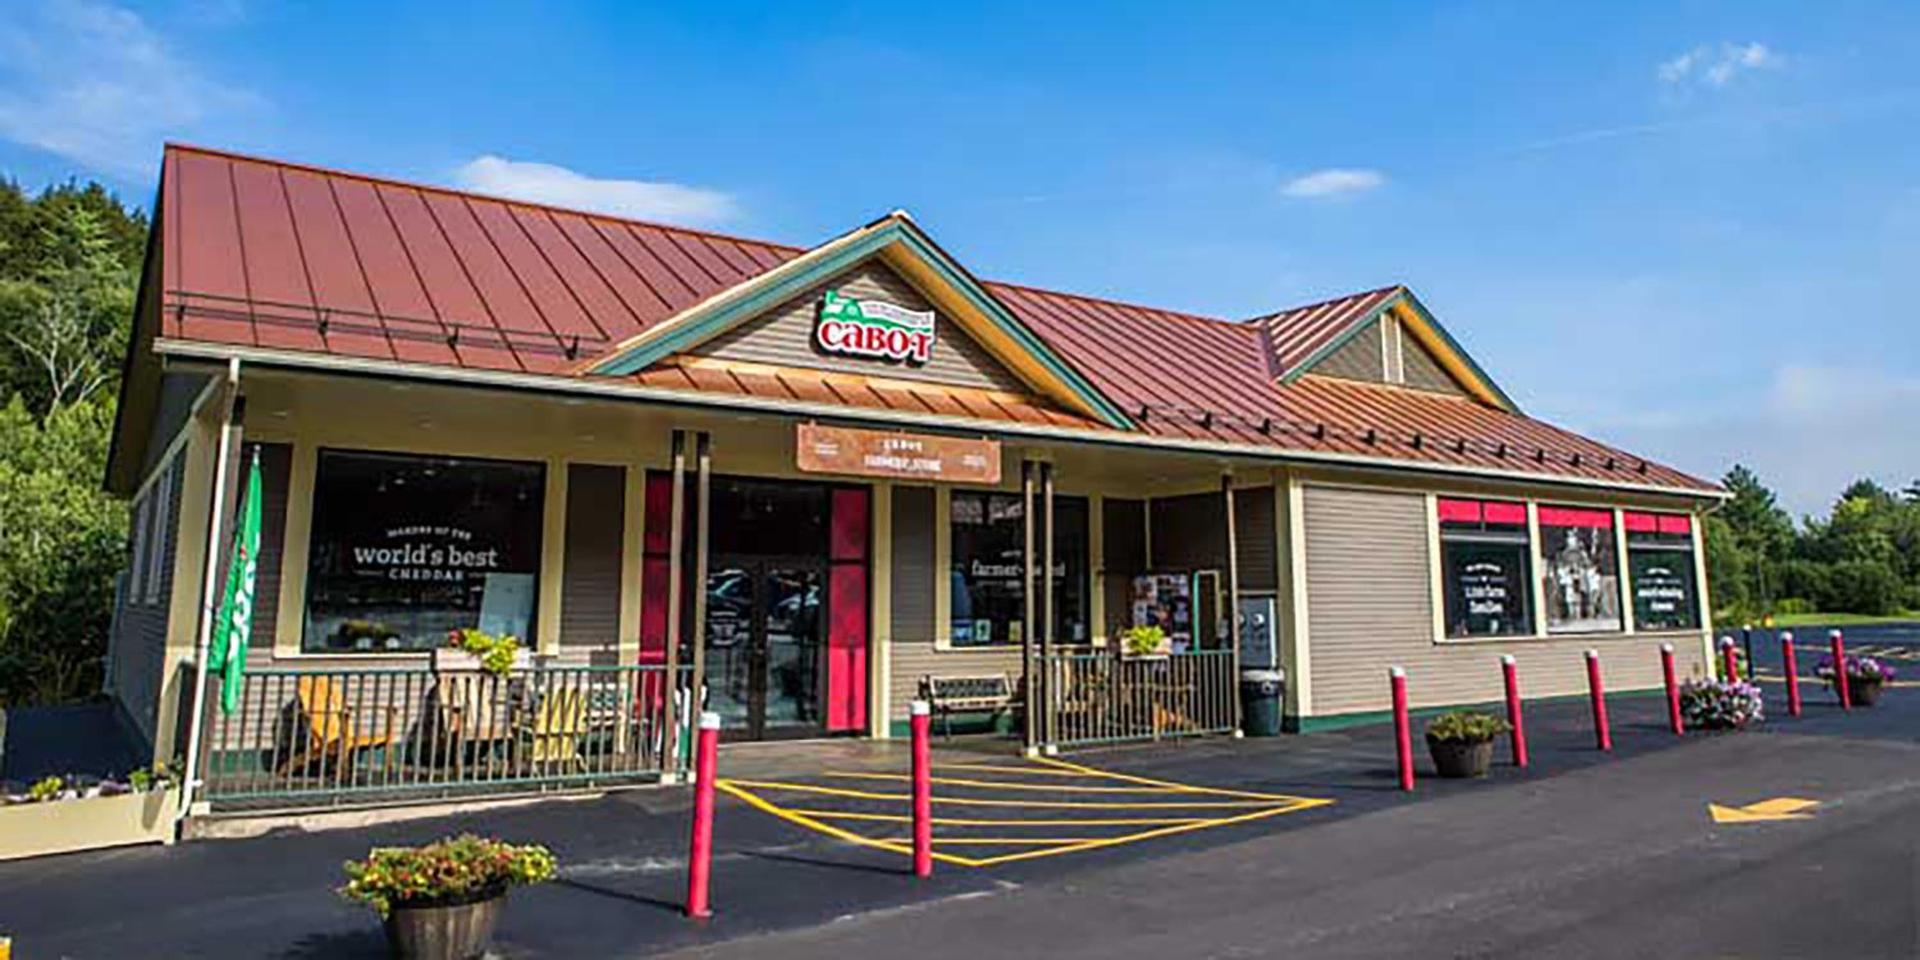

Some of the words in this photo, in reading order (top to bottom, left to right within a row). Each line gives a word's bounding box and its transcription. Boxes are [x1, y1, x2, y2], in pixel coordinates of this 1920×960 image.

[354, 544, 444, 565] world's
[448, 545, 499, 567] best
[389, 568, 464, 580] CHEDDAR
